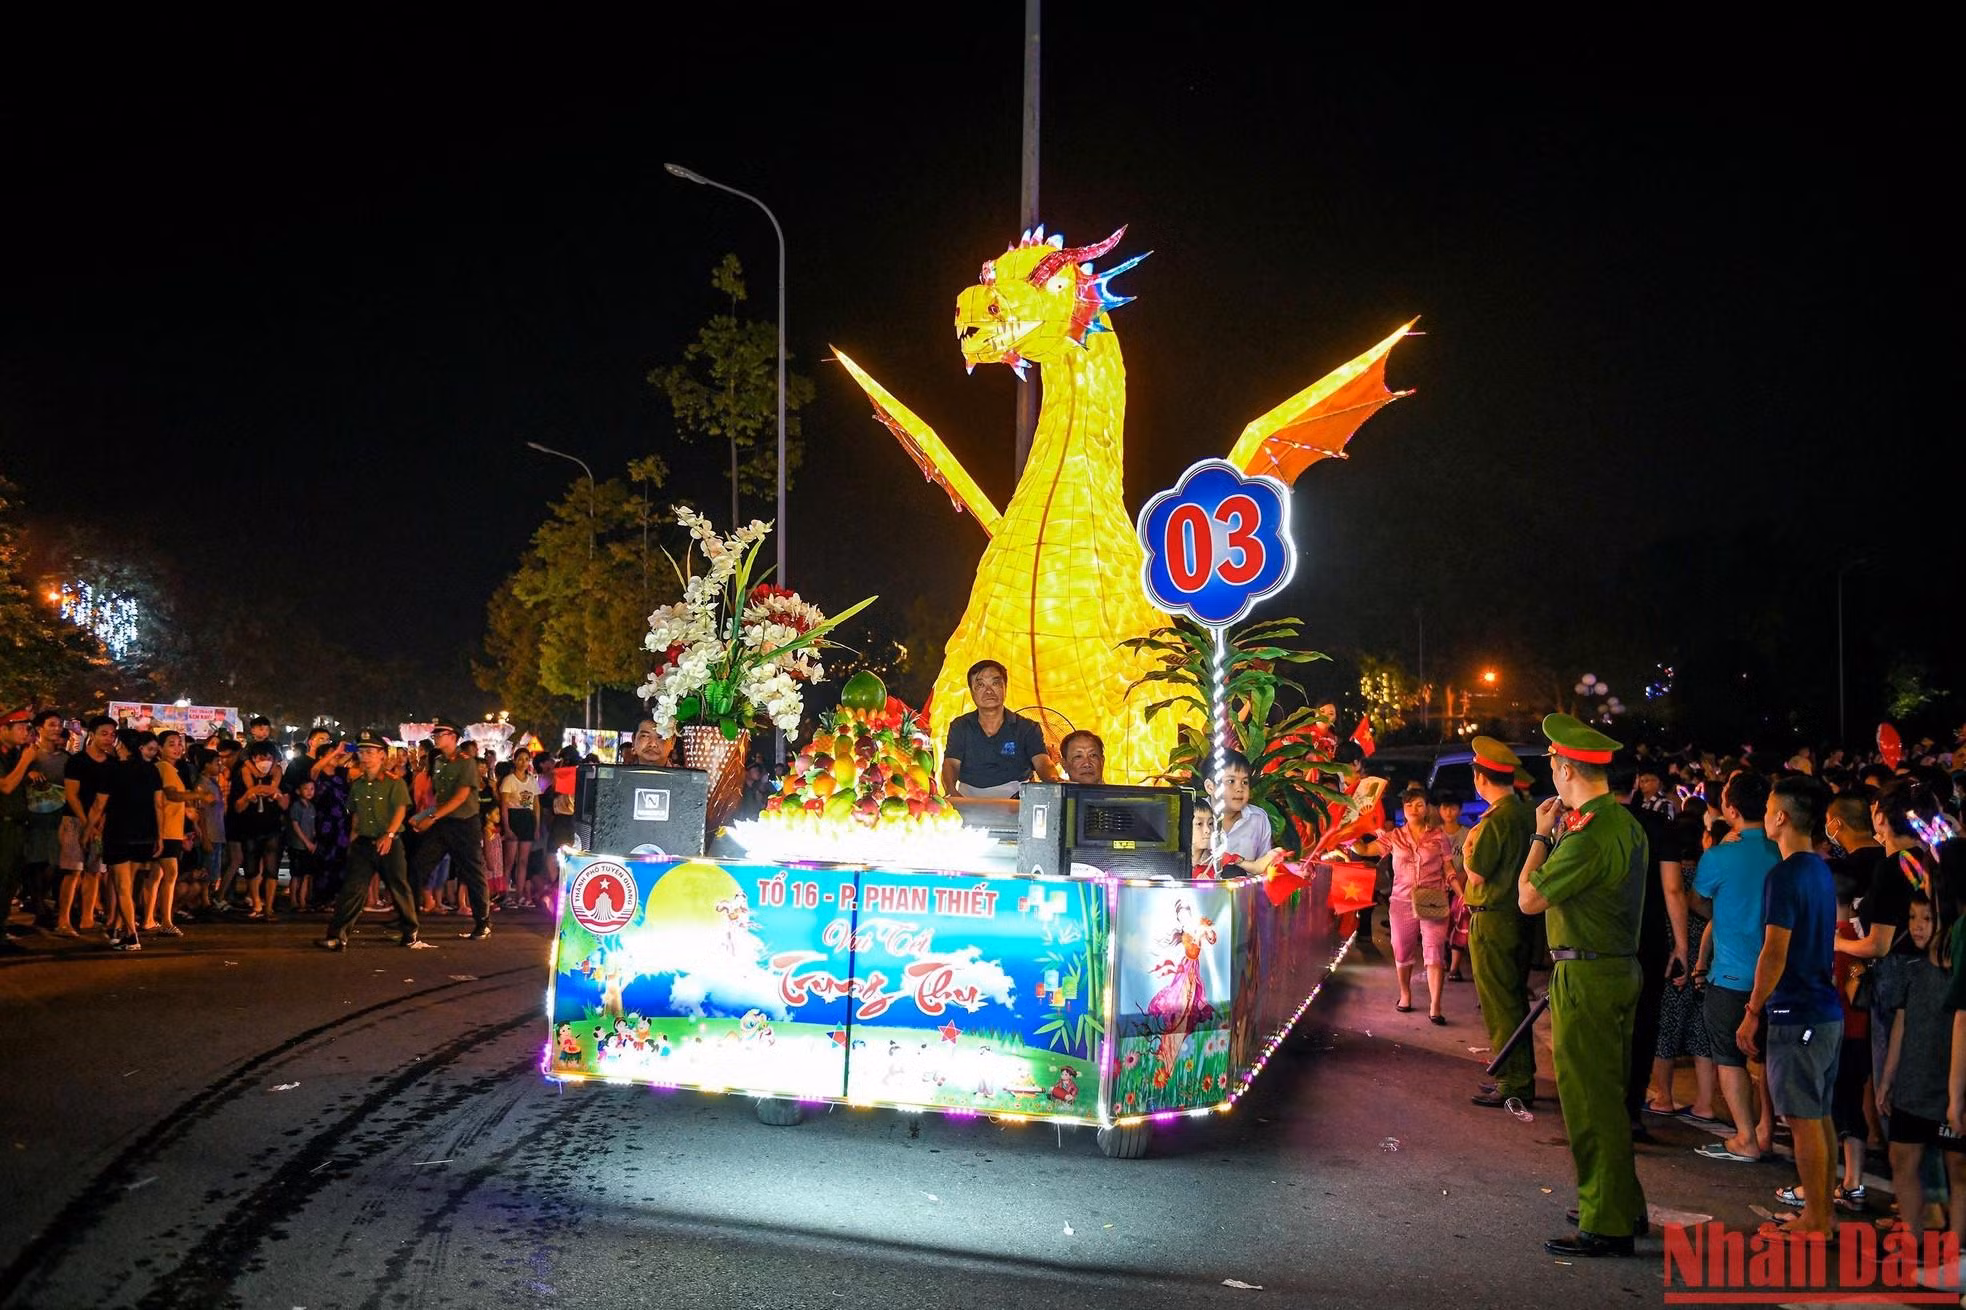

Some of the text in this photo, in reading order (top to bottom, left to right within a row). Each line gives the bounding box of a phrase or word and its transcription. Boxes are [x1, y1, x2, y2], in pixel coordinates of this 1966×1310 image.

[1164, 494, 1267, 594] 03
[623, 878, 633, 905] QUANG
[758, 870, 787, 906] TỔ
[792, 881, 819, 908] 16
[864, 885, 928, 912] PHAN
[934, 881, 998, 916] THIẾT
[770, 954, 980, 1018] Trung Thu
